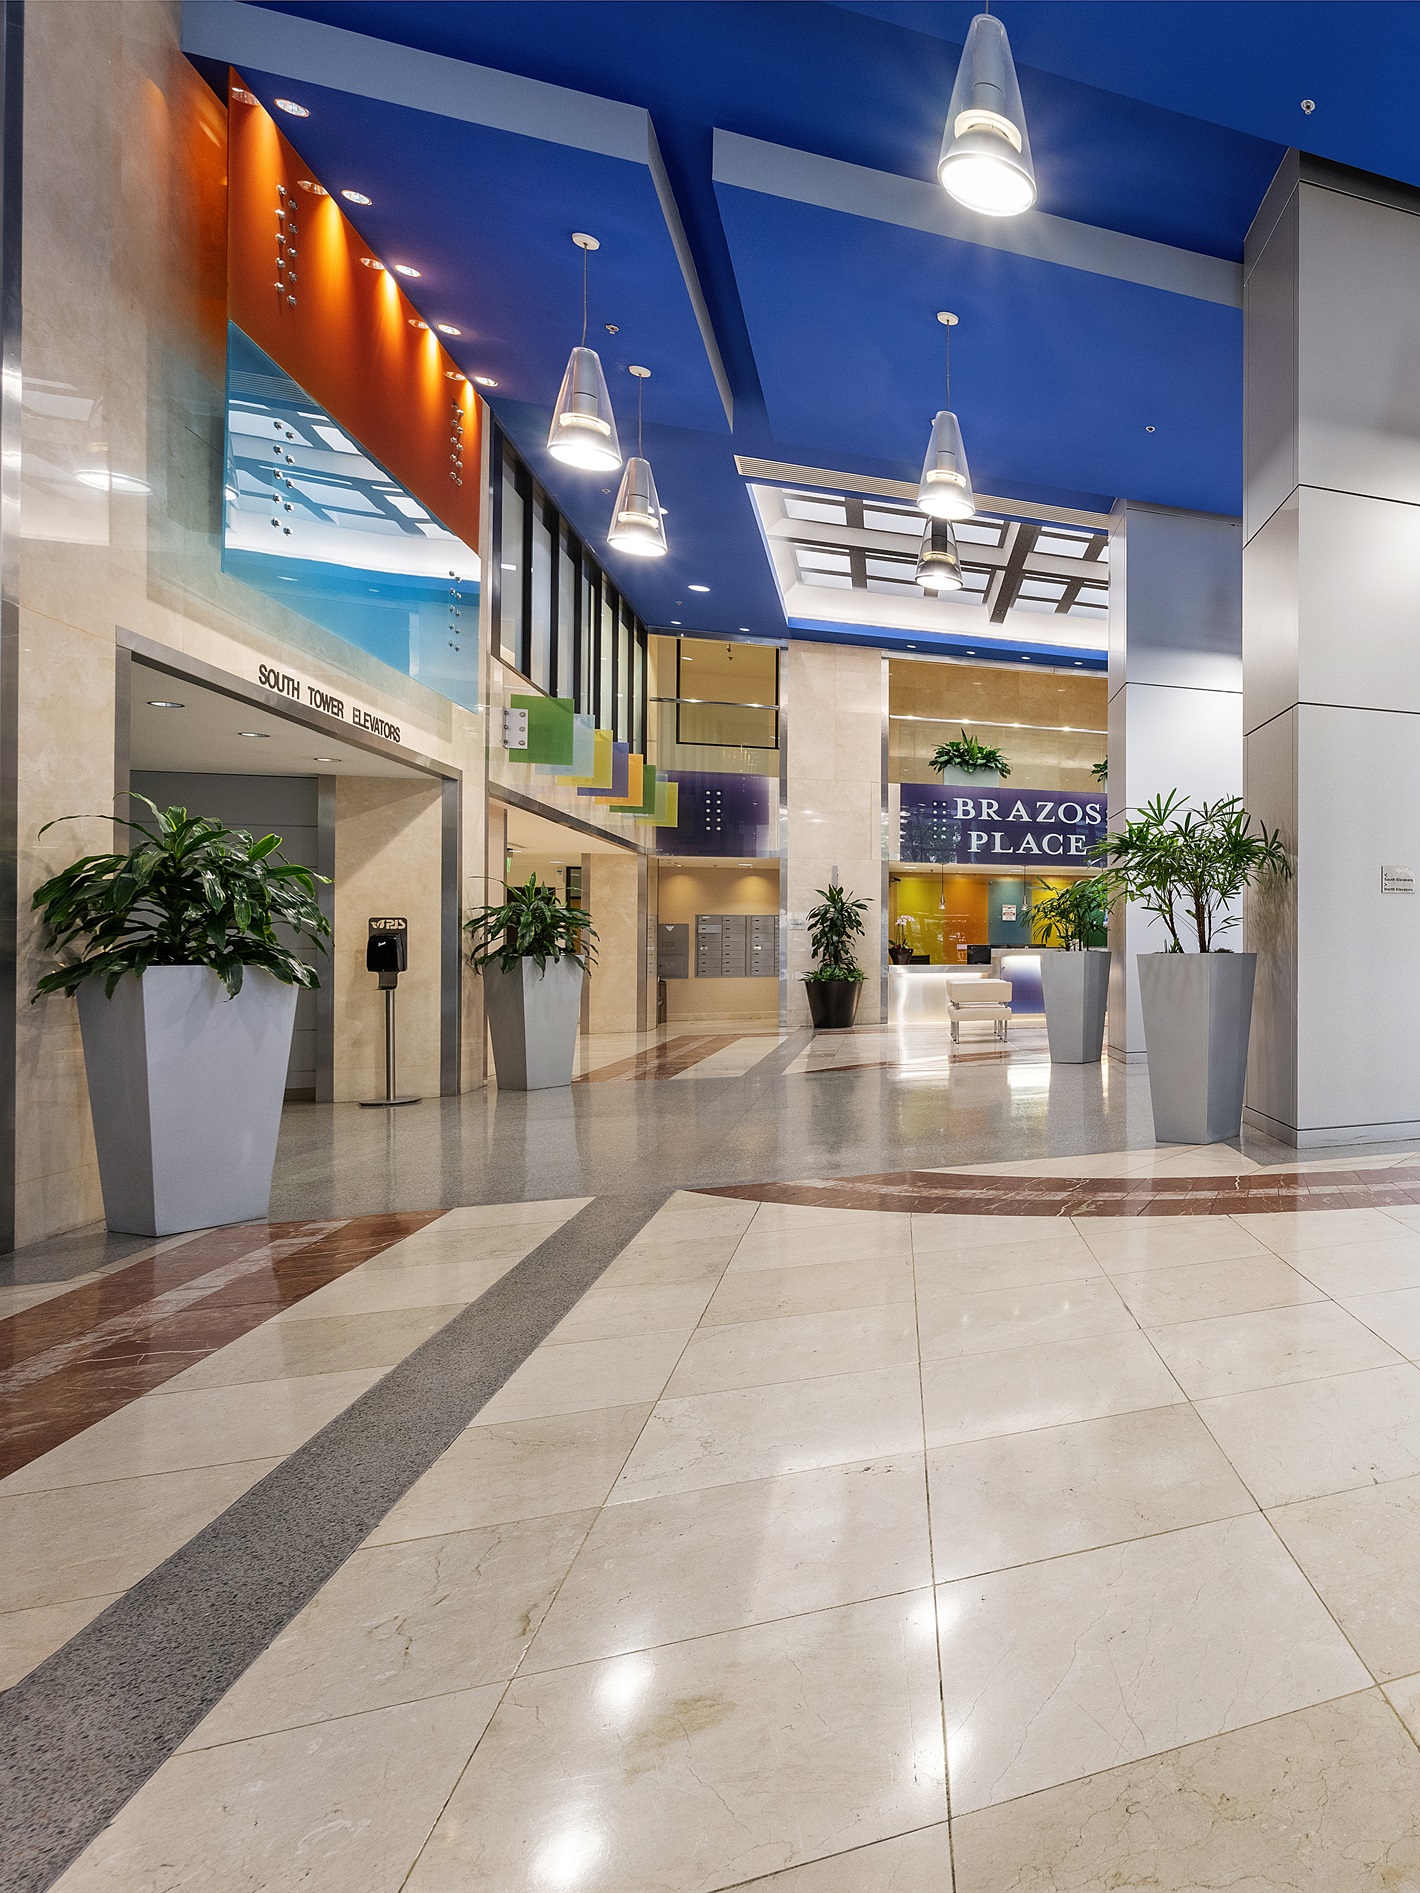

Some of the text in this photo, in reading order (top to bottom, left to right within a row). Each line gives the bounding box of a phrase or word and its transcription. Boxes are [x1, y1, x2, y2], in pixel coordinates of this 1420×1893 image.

[259, 664, 401, 743] SOUTH TOWER ELEVATORS
[953, 797, 1102, 825] BRAZOS
[967, 831, 1088, 856] PLACE
